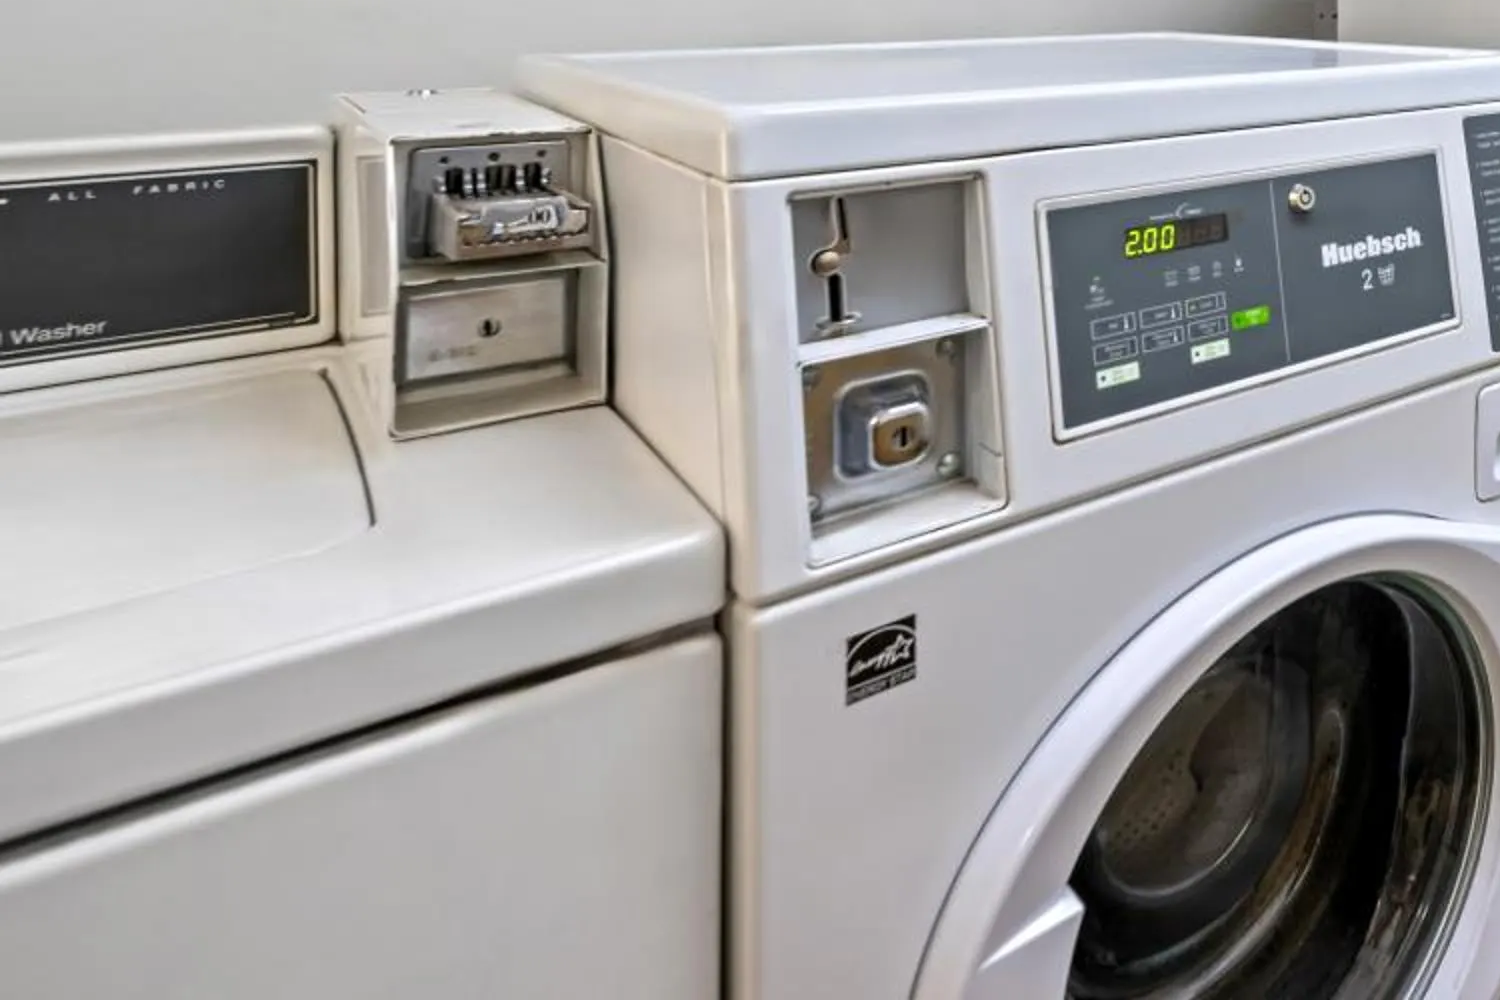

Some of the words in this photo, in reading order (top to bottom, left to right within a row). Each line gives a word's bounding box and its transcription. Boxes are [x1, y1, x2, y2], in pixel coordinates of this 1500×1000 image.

[48, 190, 97, 202] ALL
[132, 179, 225, 196] FABRIC
[1125, 223, 1176, 257] 2.00
[1321, 226, 1422, 268] Huebsch
[1361, 268, 1375, 291] 2
[9, 320, 108, 345] Washer
